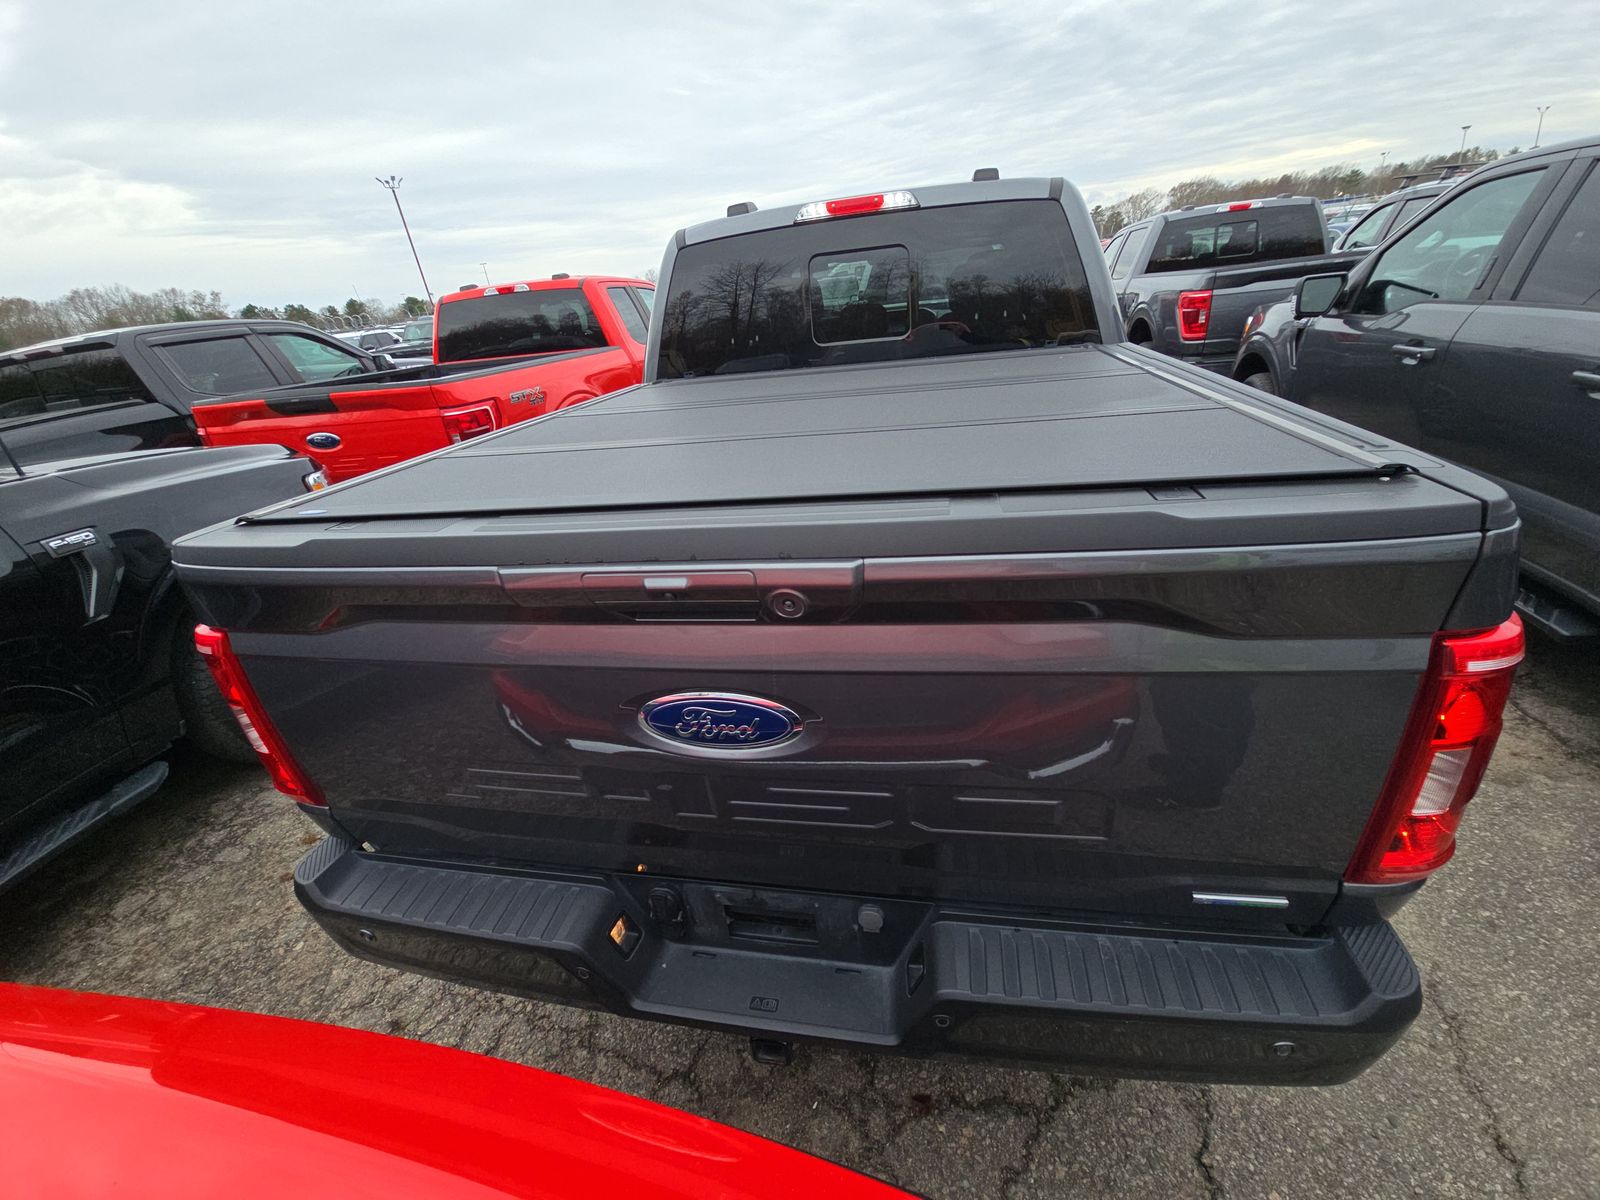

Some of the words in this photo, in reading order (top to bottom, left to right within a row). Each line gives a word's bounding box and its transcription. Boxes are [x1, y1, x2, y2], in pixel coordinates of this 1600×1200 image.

[510, 386, 544, 403] STX
[48, 532, 95, 549] F-150
[674, 706, 760, 740] Ford
